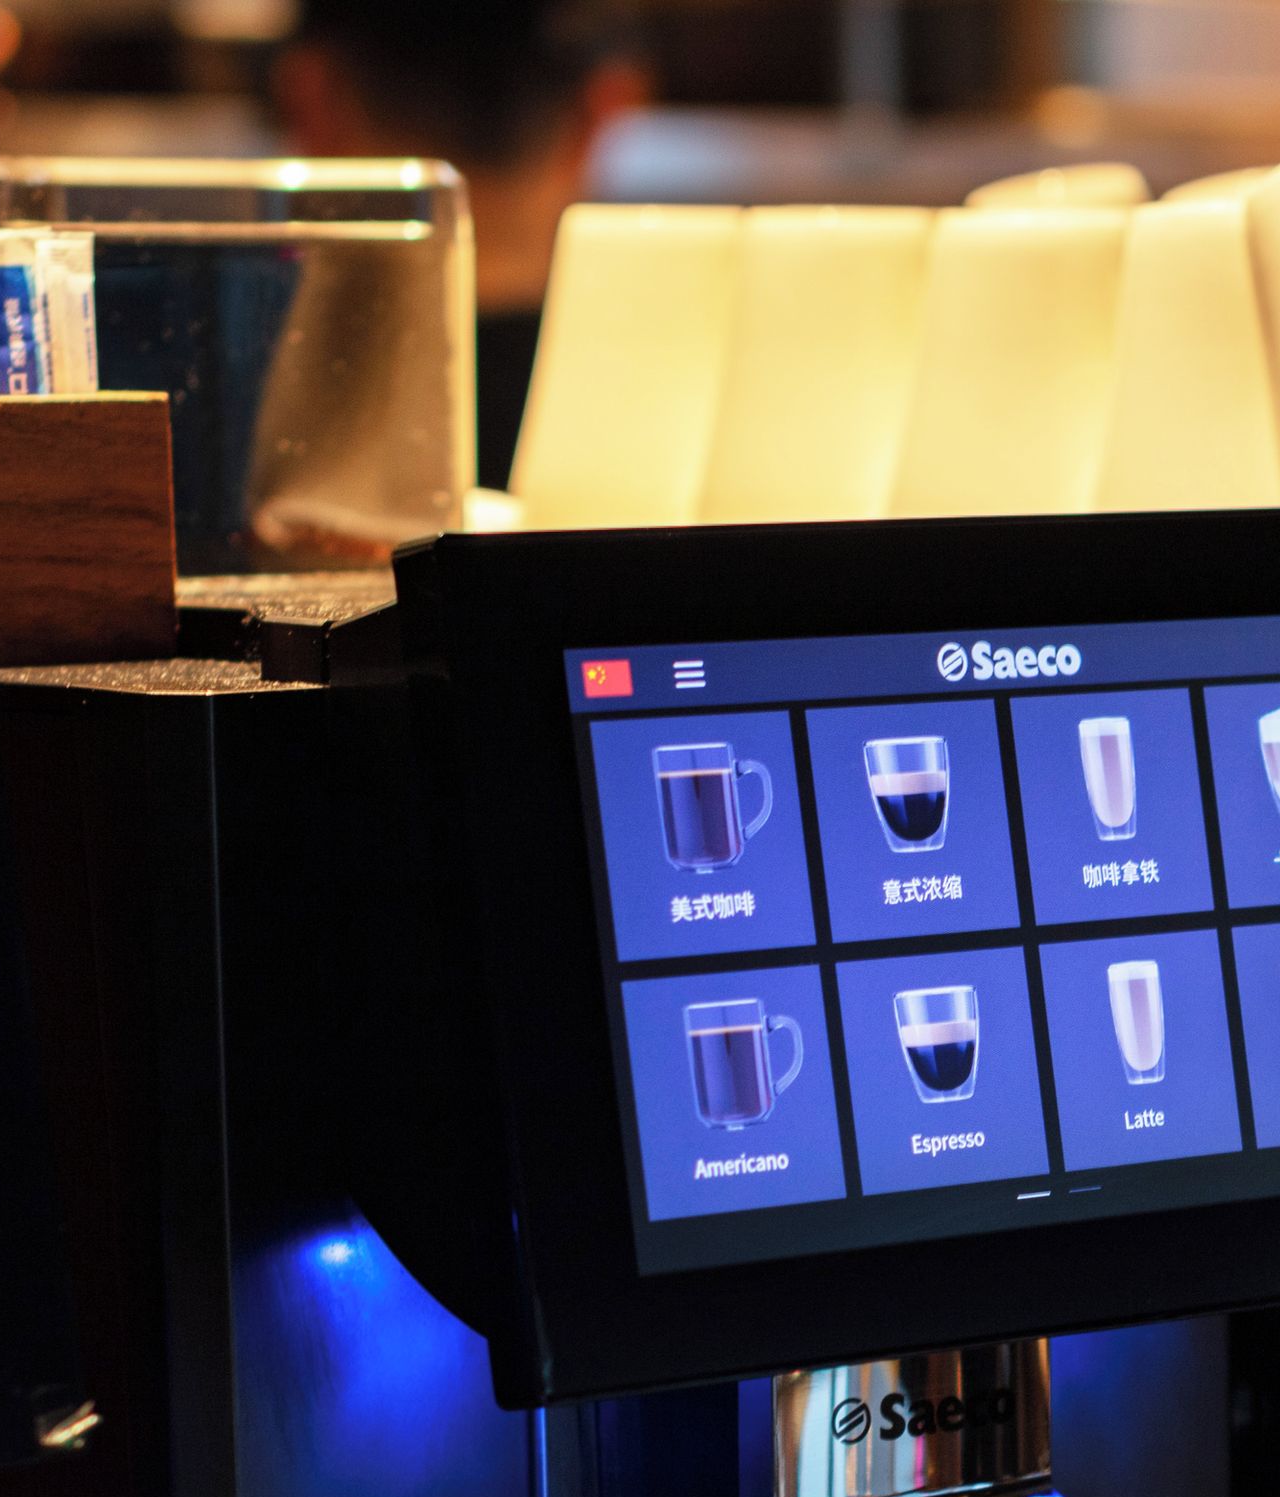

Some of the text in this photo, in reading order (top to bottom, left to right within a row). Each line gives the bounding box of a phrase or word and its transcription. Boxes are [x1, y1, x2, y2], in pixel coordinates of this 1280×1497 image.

[972, 641, 1081, 680] Saeco
[1082, 858, 1160, 888] 咖啡拿铁
[883, 874, 962, 905] 意式浓缩
[671, 890, 755, 922] 美式咖啡
[1124, 1107, 1165, 1131] Latte
[911, 1130, 985, 1157] Espresso
[694, 1152, 789, 1180] Americano
[879, 1389, 1016, 1441] Saeo
